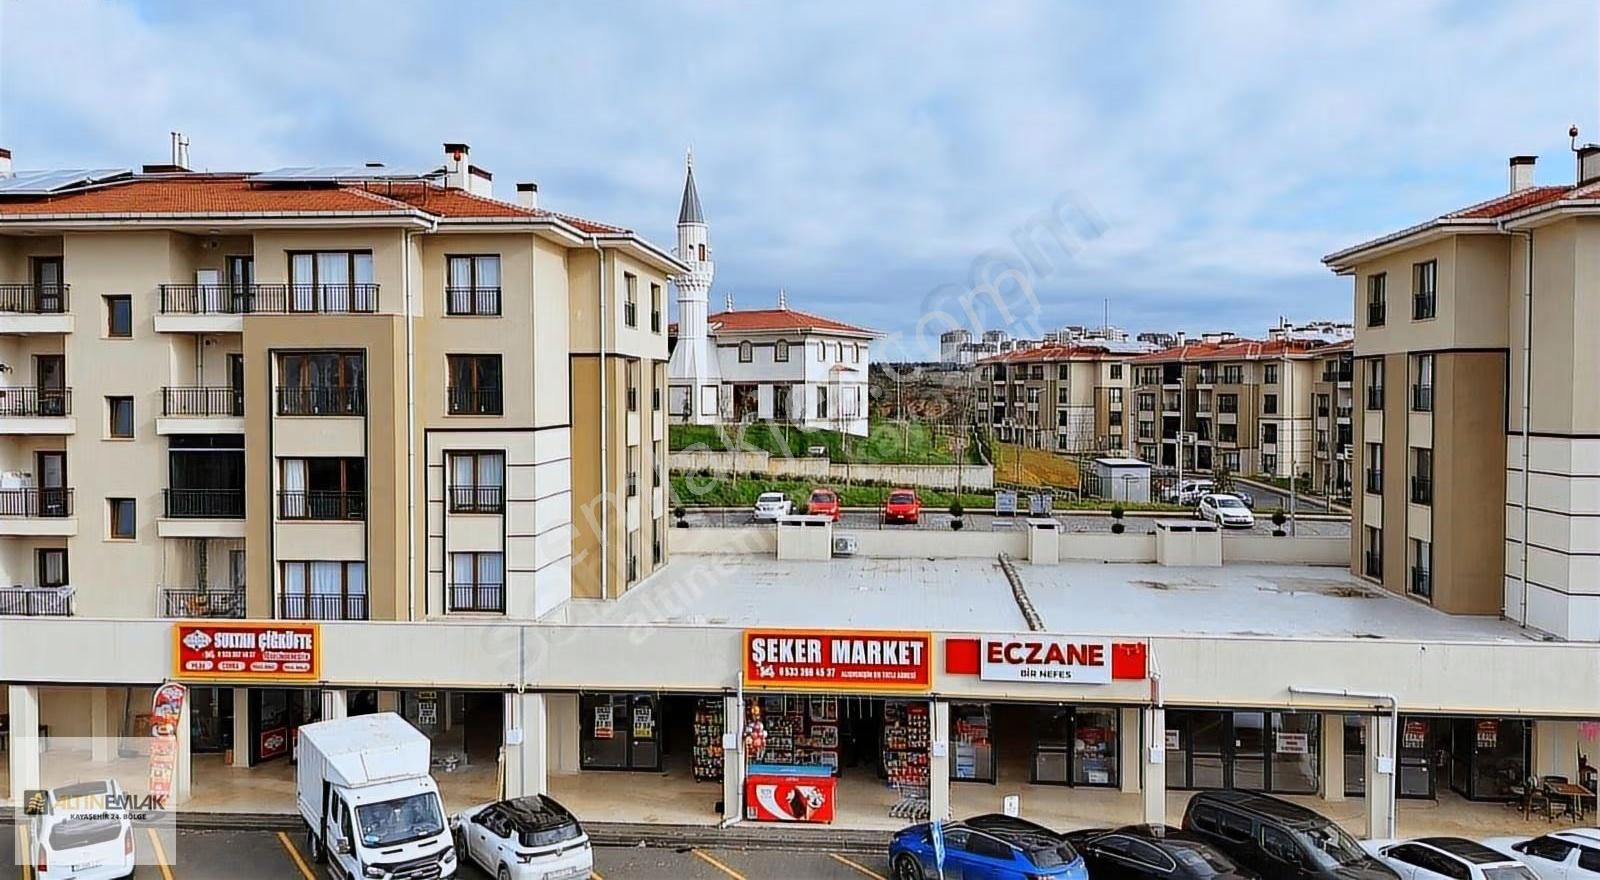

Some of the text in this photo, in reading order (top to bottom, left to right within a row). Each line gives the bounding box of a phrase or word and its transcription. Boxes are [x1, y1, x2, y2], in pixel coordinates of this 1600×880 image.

[214, 632, 256, 649] SULTAN
[752, 637, 924, 667] ŞEKER MARKET
[987, 641, 1105, 667] ECZANE
[785, 667, 799, 677] 533
[1020, 667, 1072, 679] BİR NEFES
